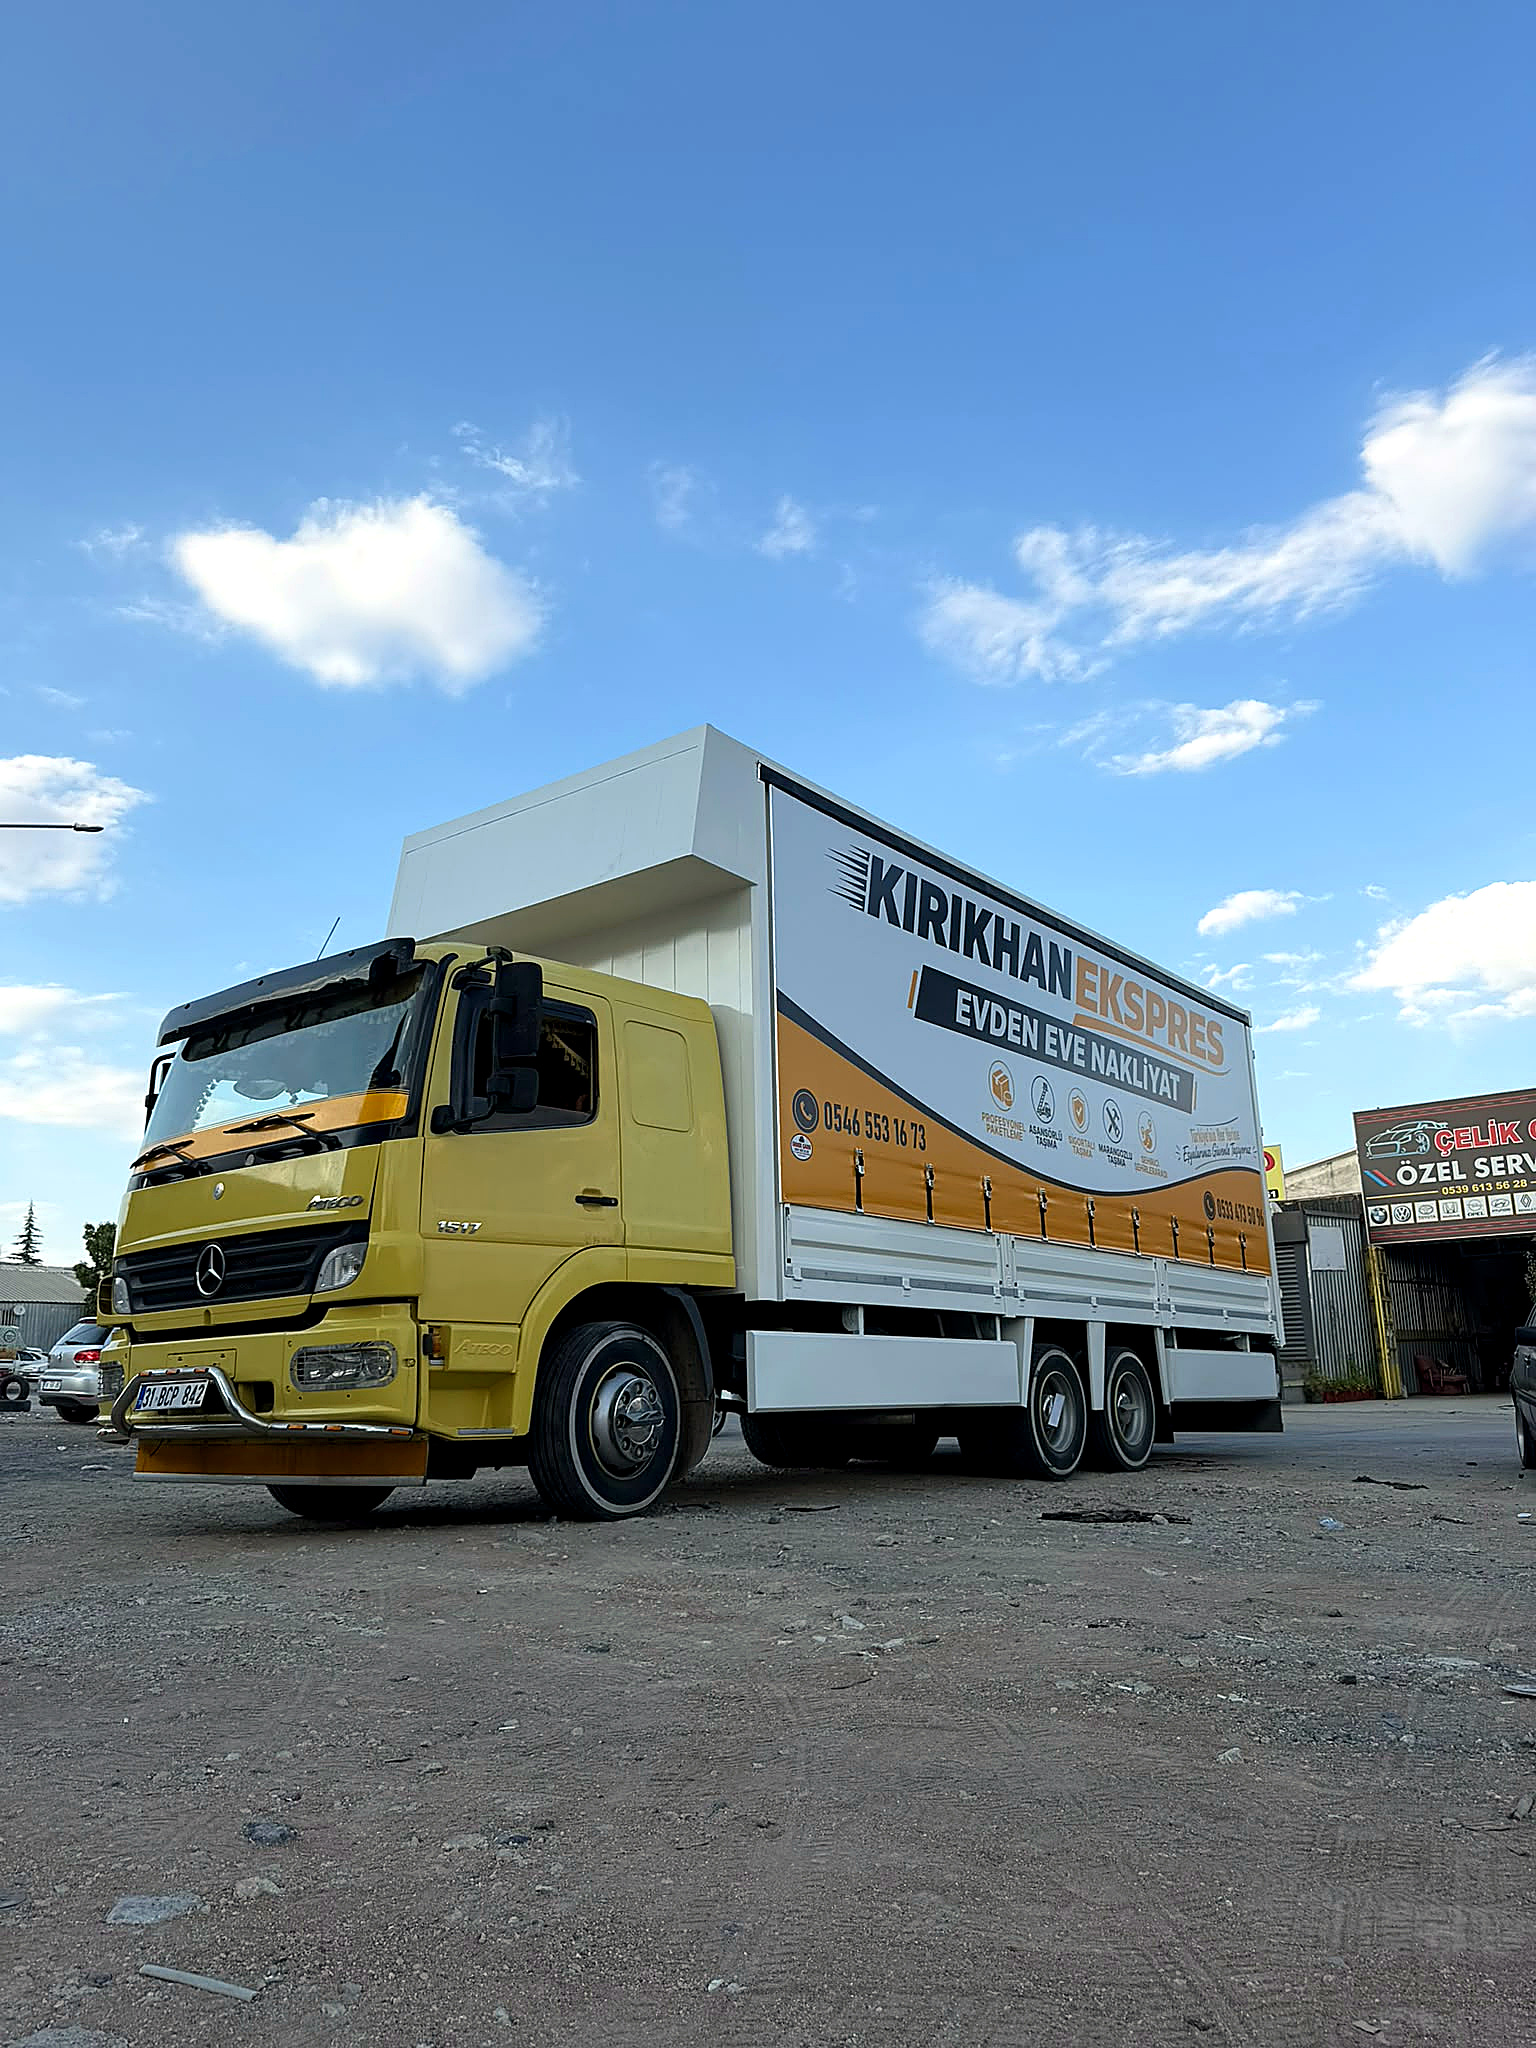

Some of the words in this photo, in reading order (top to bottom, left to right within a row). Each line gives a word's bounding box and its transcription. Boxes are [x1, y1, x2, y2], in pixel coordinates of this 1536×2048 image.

[868, 855, 1072, 1000] KIRIKHAN
[1076, 956, 1224, 1065] EKSPRES
[956, 989, 1038, 1051] EVDEN
[1045, 1024, 1086, 1067] EVE
[1091, 1041, 1180, 1102] NAKLİYAT
[824, 1101, 860, 1137] 0546
[864, 1110, 890, 1143] 553
[893, 1118, 907, 1147] 16
[910, 1122, 927, 1151] 73
[982, 1112, 1025, 1132] PROFESYONEL
[986, 1123, 1023, 1141] PAKETLEME
[1029, 1124, 1062, 1141] ASANSÖRLÜ
[1434, 1118, 1524, 1157] ÇELİK
[1396, 1160, 1467, 1186] ÖZEL
[1441, 1184, 1469, 1195] 0539
[1472, 1182, 1493, 1193] 613
[1496, 1181, 1510, 1190] 56
[1513, 1179, 1528, 1188] 28
[1216, 1198, 1233, 1219] 0533
[1234, 1203, 1247, 1222] 473
[437, 1220, 482, 1235] 1517
[143, 1387, 156, 1408] 31
[157, 1386, 180, 1407] BCP
[182, 1384, 205, 1405] 842
